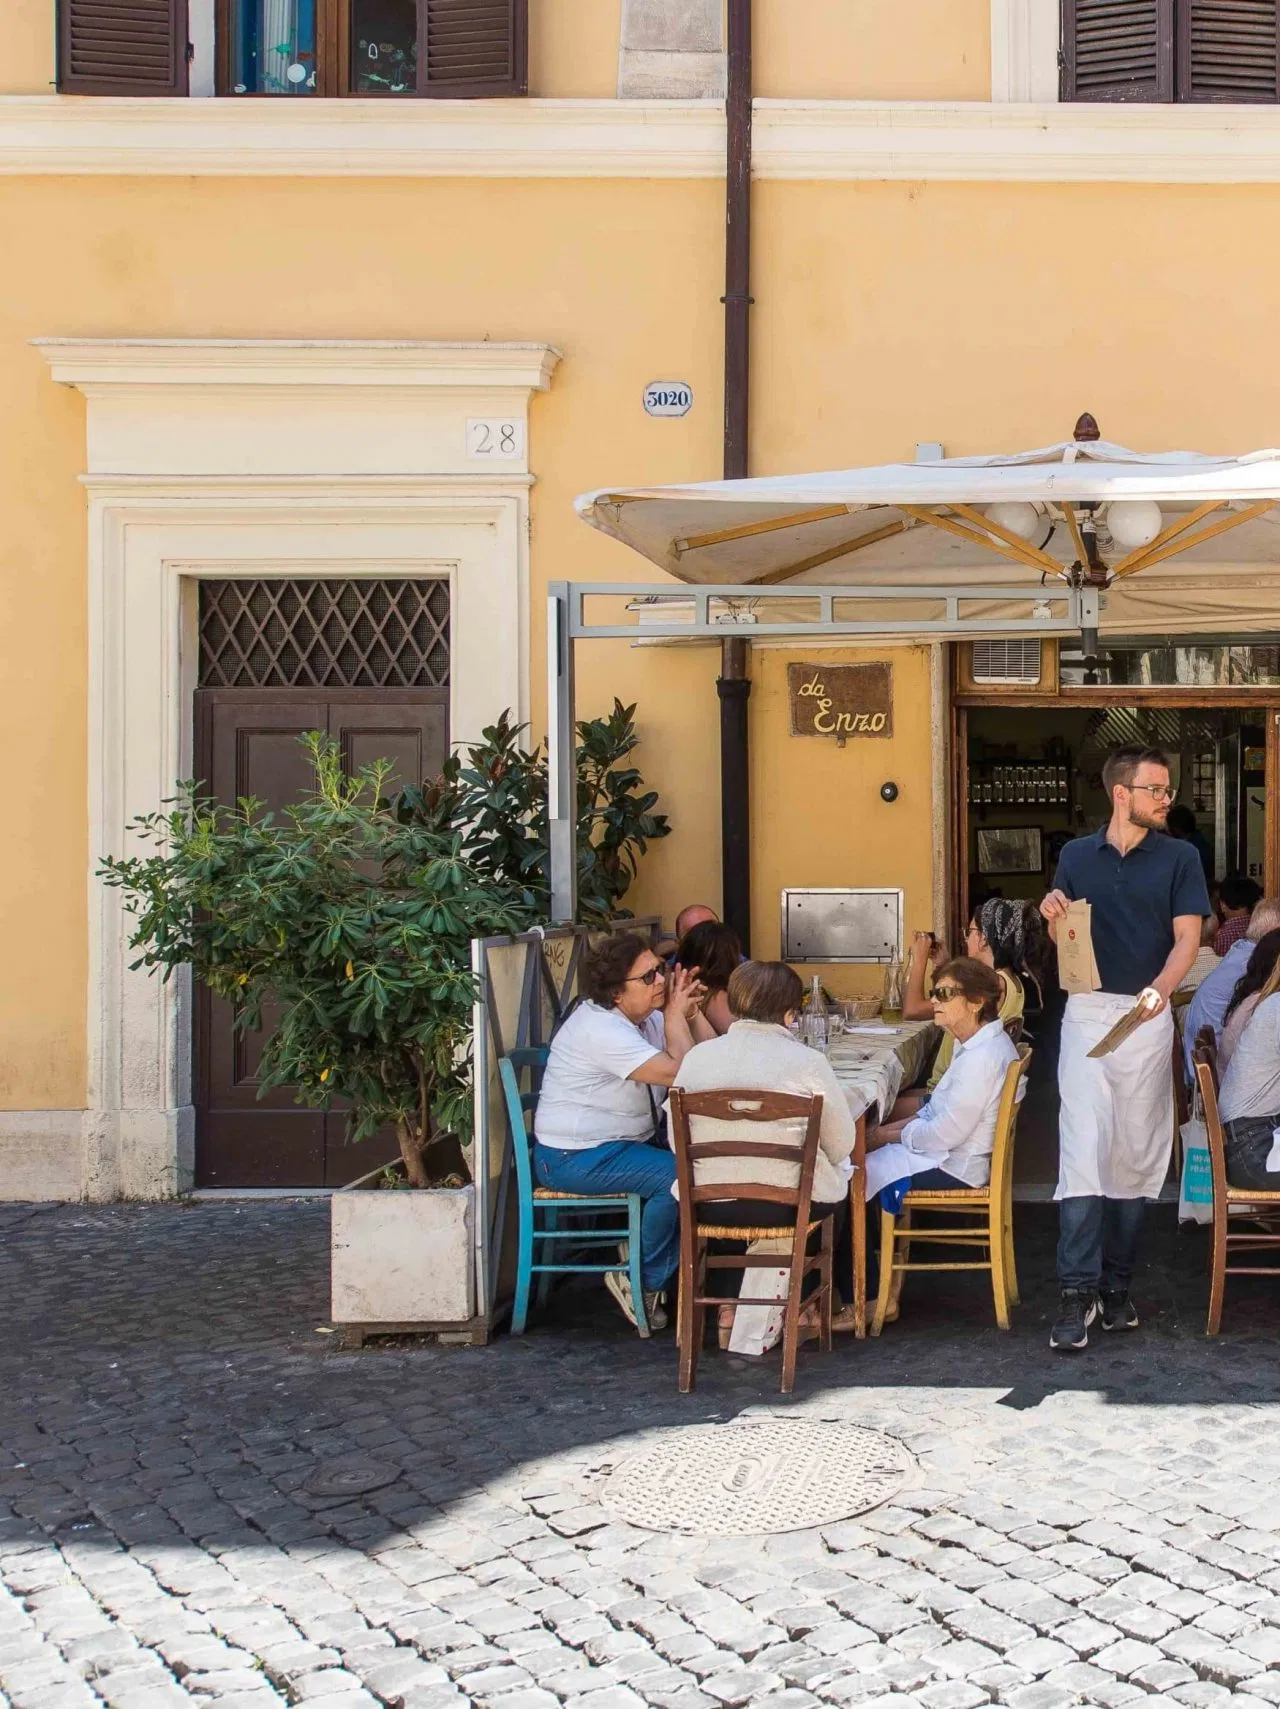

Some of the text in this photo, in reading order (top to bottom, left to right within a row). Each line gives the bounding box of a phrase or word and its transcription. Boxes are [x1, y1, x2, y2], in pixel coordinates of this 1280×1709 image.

[647, 391, 688, 407] 3020
[473, 423, 516, 454] 28
[797, 672, 826, 696] da
[813, 698, 888, 732] Enzo
